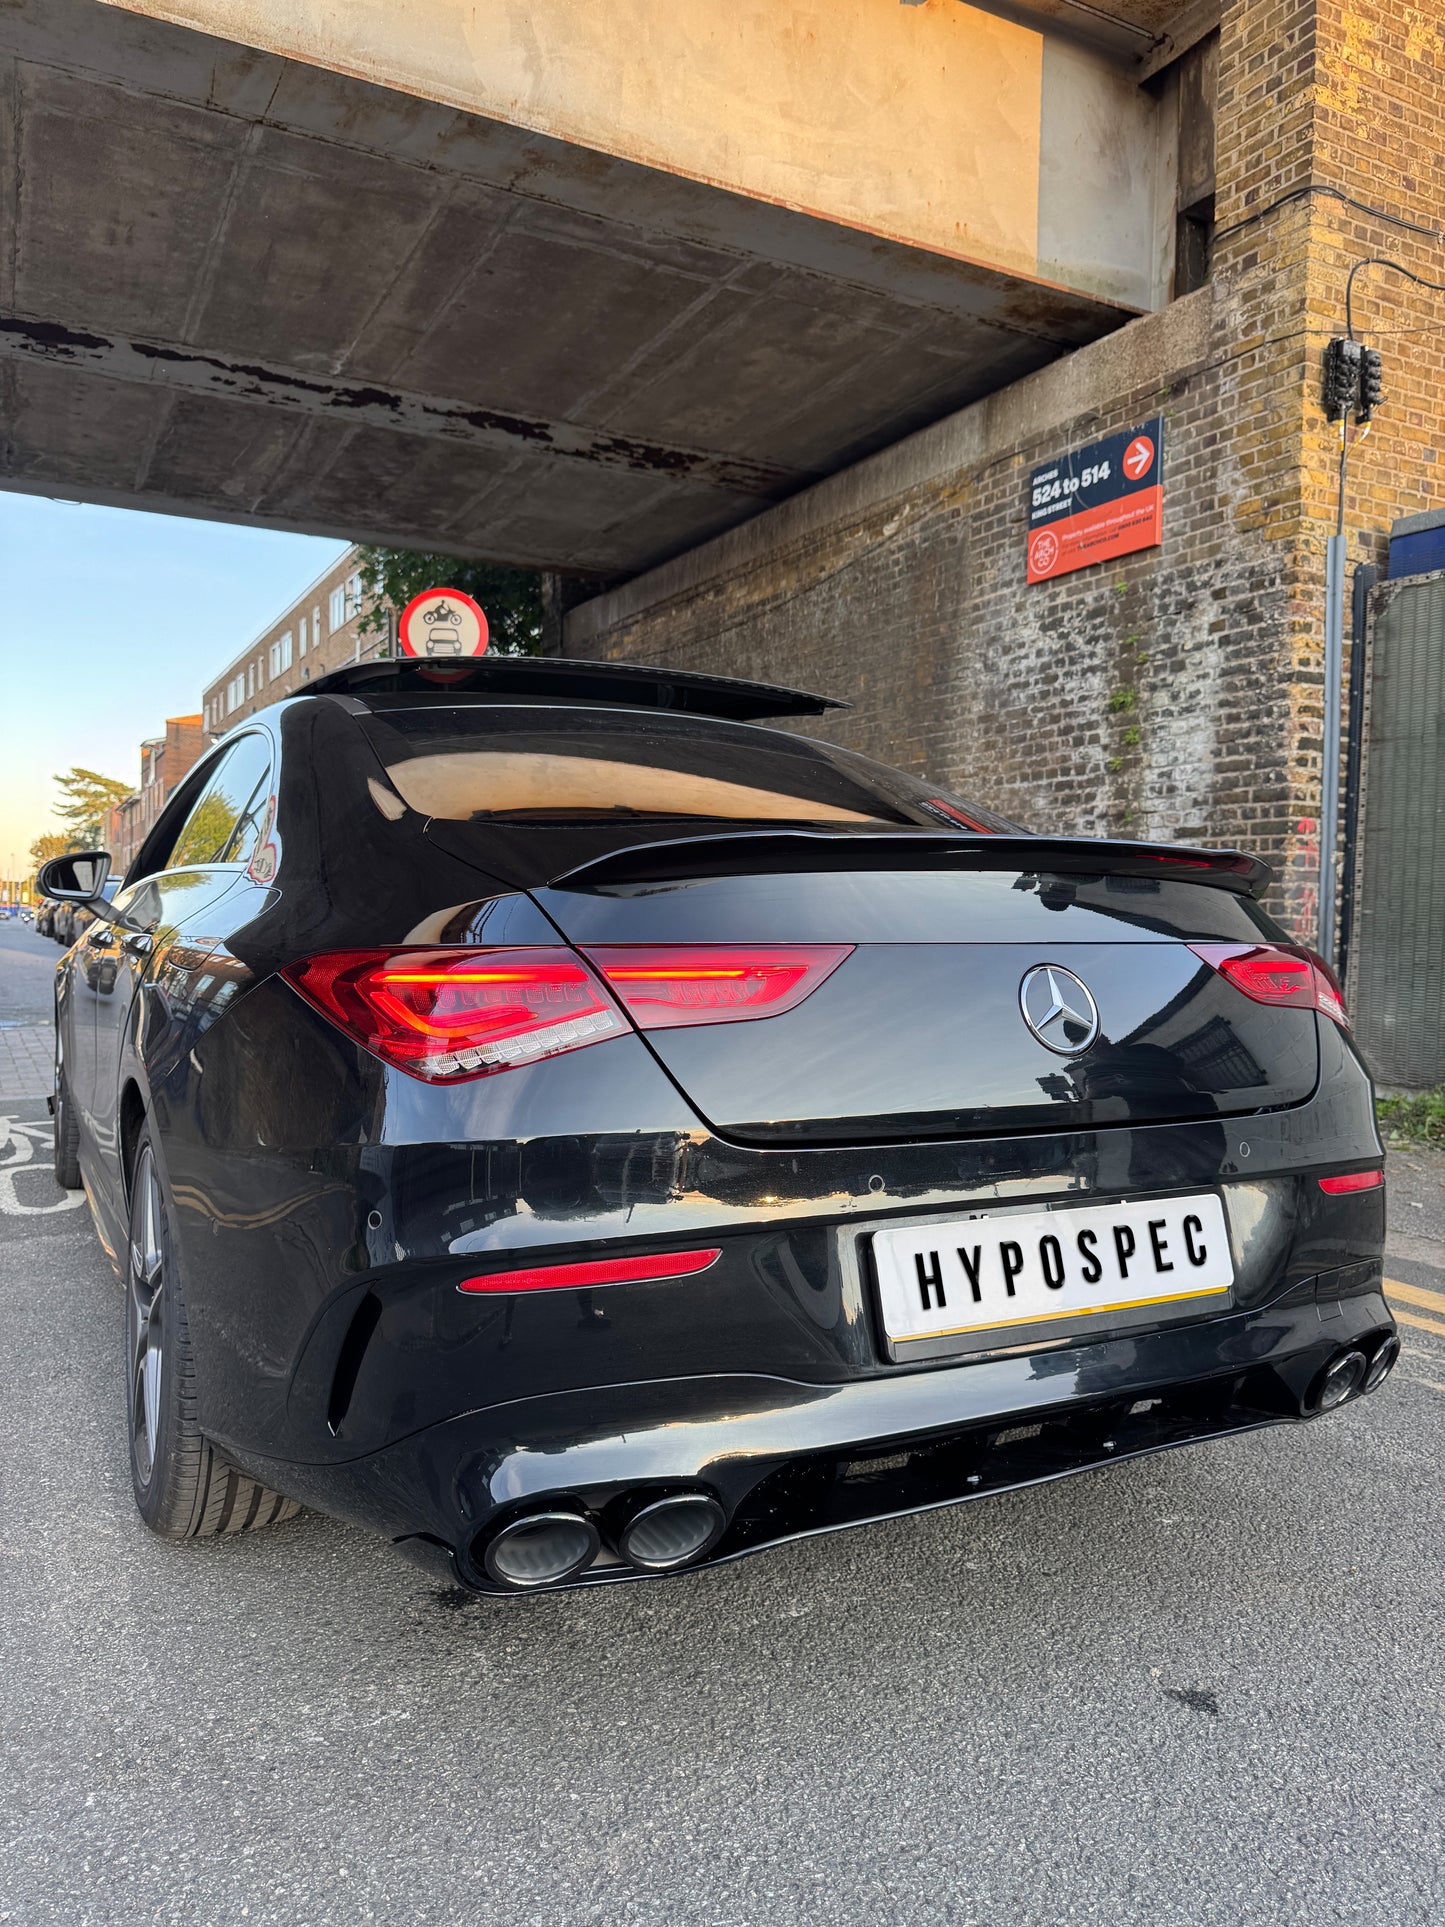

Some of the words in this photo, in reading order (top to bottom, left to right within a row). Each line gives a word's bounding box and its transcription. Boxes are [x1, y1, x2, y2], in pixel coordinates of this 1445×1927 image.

[1031, 480, 1062, 506] 524
[1062, 477, 1080, 495] to
[1081, 460, 1111, 488] 514
[1032, 468, 1059, 486] ARCHES
[1031, 507, 1047, 520] KING
[1047, 497, 1073, 515] STREET
[1037, 537, 1051, 550] THE
[1034, 545, 1055, 561] ARCH
[1037, 556, 1050, 568] CO
[914, 1213, 1208, 1311] HYPOSPEC
